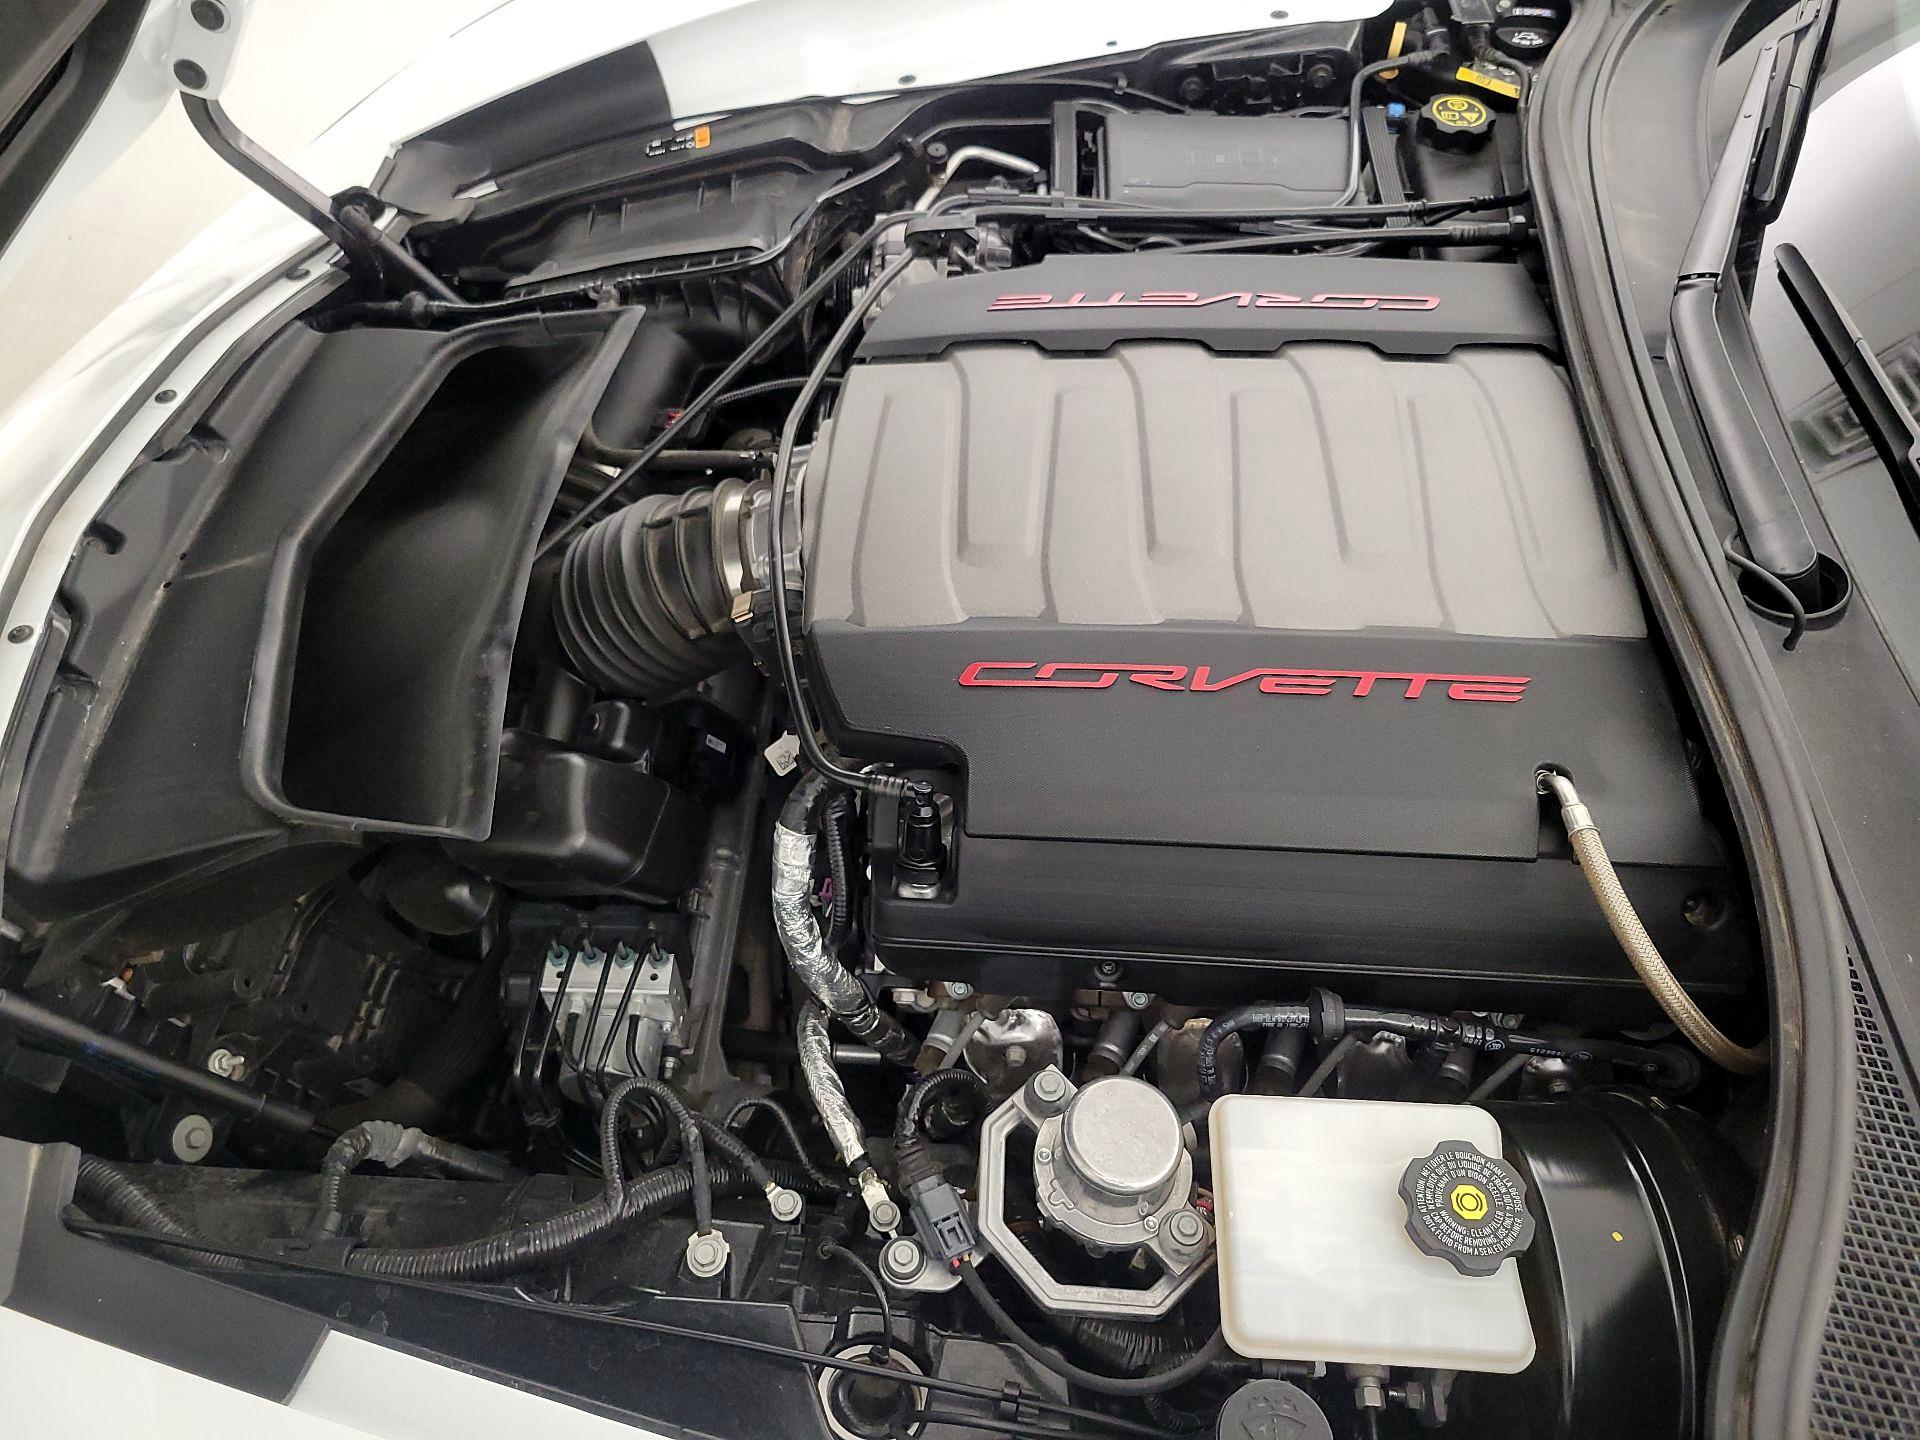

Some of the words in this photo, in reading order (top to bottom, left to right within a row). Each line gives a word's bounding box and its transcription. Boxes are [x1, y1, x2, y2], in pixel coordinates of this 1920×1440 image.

[986, 292, 1440, 311] CORVETTE
[958, 662, 1531, 703] CORVETTE
[1435, 1163, 1448, 1176] QUE
[1447, 1161, 1457, 1170] DU
[1457, 1161, 1482, 1173] LIQUIDE
[1482, 1168, 1492, 1178] DE
[1490, 1174, 1508, 1194] FREIN
[1502, 1194, 1514, 1210] DOT4
[1444, 1152, 1455, 1160] LE
[1455, 1152, 1486, 1165] BOUCHON
[1485, 1161, 1506, 1178] AVANT
[1502, 1177, 1512, 1188] LA
[1434, 1173, 1452, 1207] PROVENANT
[1422, 1214, 1437, 1232] DOT4
[1434, 1229, 1454, 1247] FLUID
[1453, 1242, 1473, 1256] FROM
[1474, 1248, 1479, 1256] A
[1479, 1243, 1504, 1256] SEALED
[1430, 1211, 1443, 1224] CAP
[1439, 1222, 1464, 1243] BEFORE
[1496, 1226, 1508, 1239] USE
[1502, 1211, 1514, 1229] ONLY
[1440, 1209, 1470, 1236] WARNING:
[1471, 1225, 1493, 1237] CLEAN
[1488, 1210, 1505, 1232] FILLER
